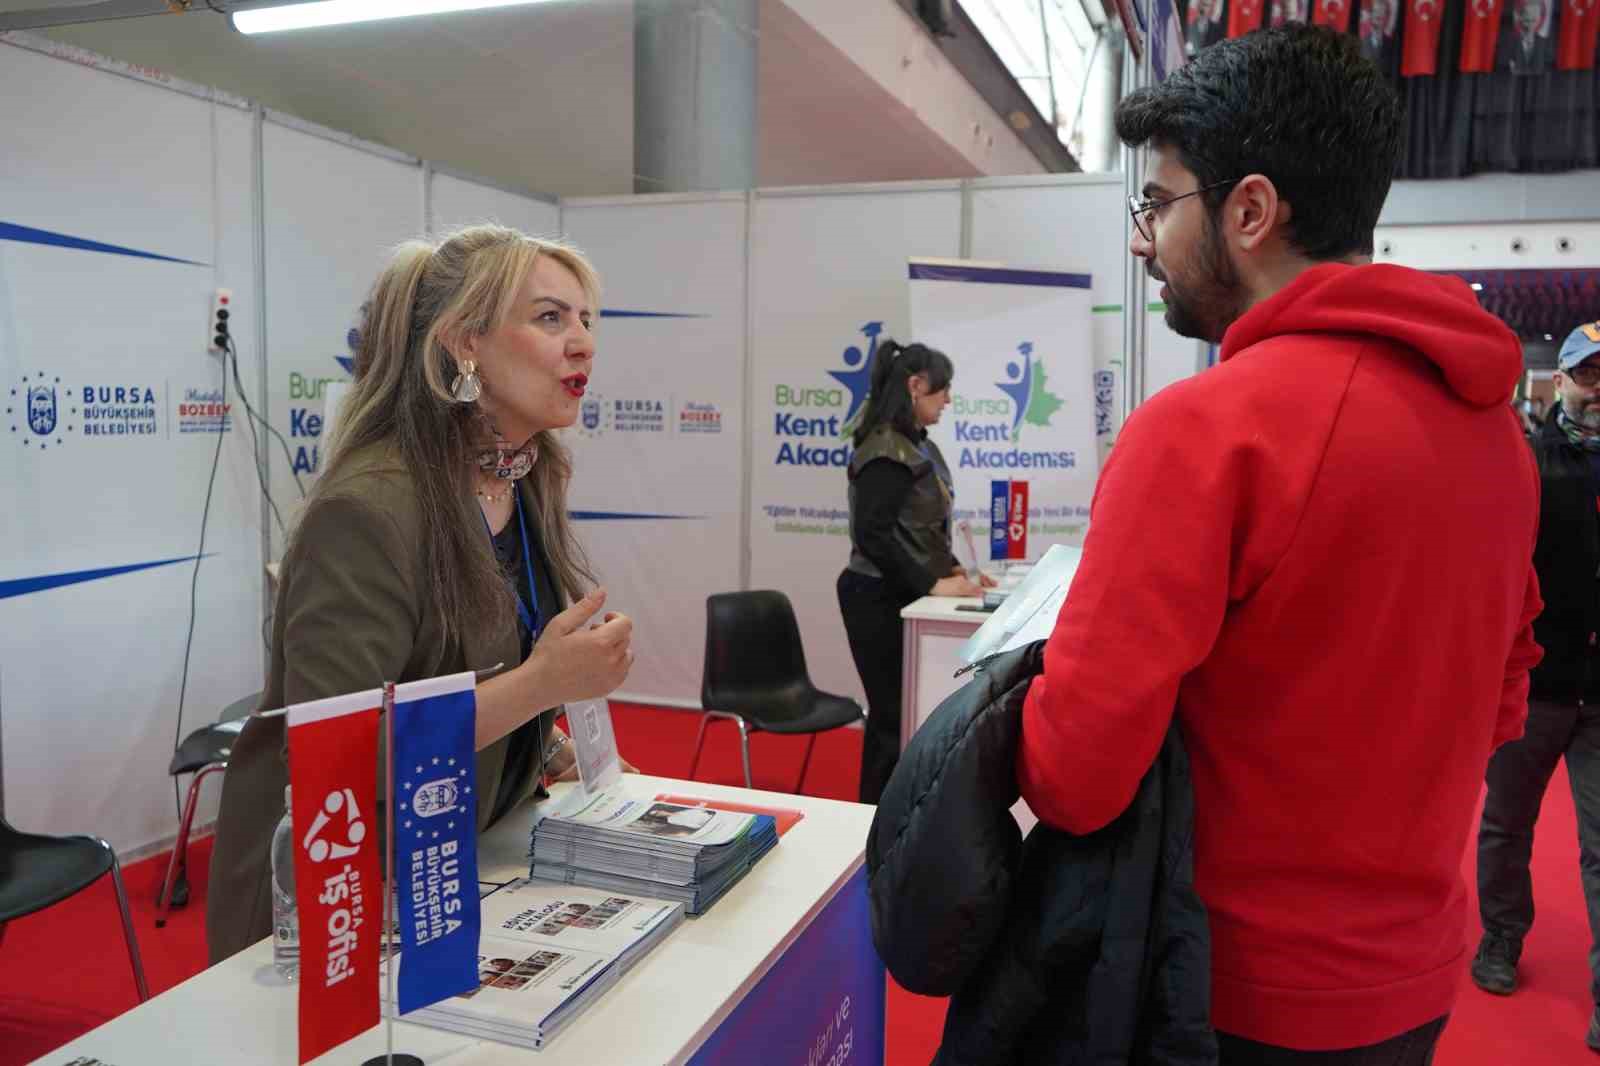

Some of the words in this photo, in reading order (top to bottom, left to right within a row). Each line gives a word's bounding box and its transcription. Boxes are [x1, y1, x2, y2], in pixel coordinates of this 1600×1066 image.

[83, 386, 156, 404] BURSA
[615, 400, 663, 412] BURSA
[775, 384, 843, 407] Bursa
[952, 392, 1010, 416] Bursa
[83, 406, 155, 420] BÜYÜKŞEHİR
[291, 408, 322, 437] Ke
[775, 412, 839, 437] Kent
[84, 421, 157, 436] BELEDİYESİ
[954, 420, 1009, 442] Kent
[960, 447, 1076, 469] Akademisi
[411, 850, 432, 946] BELEDİYESİ
[426, 845, 445, 940] BÜYÜKŞEHİR
[441, 840, 462, 935] BURSA
[347, 870, 364, 930] BURSA
[835, 995, 850, 1032] ve
